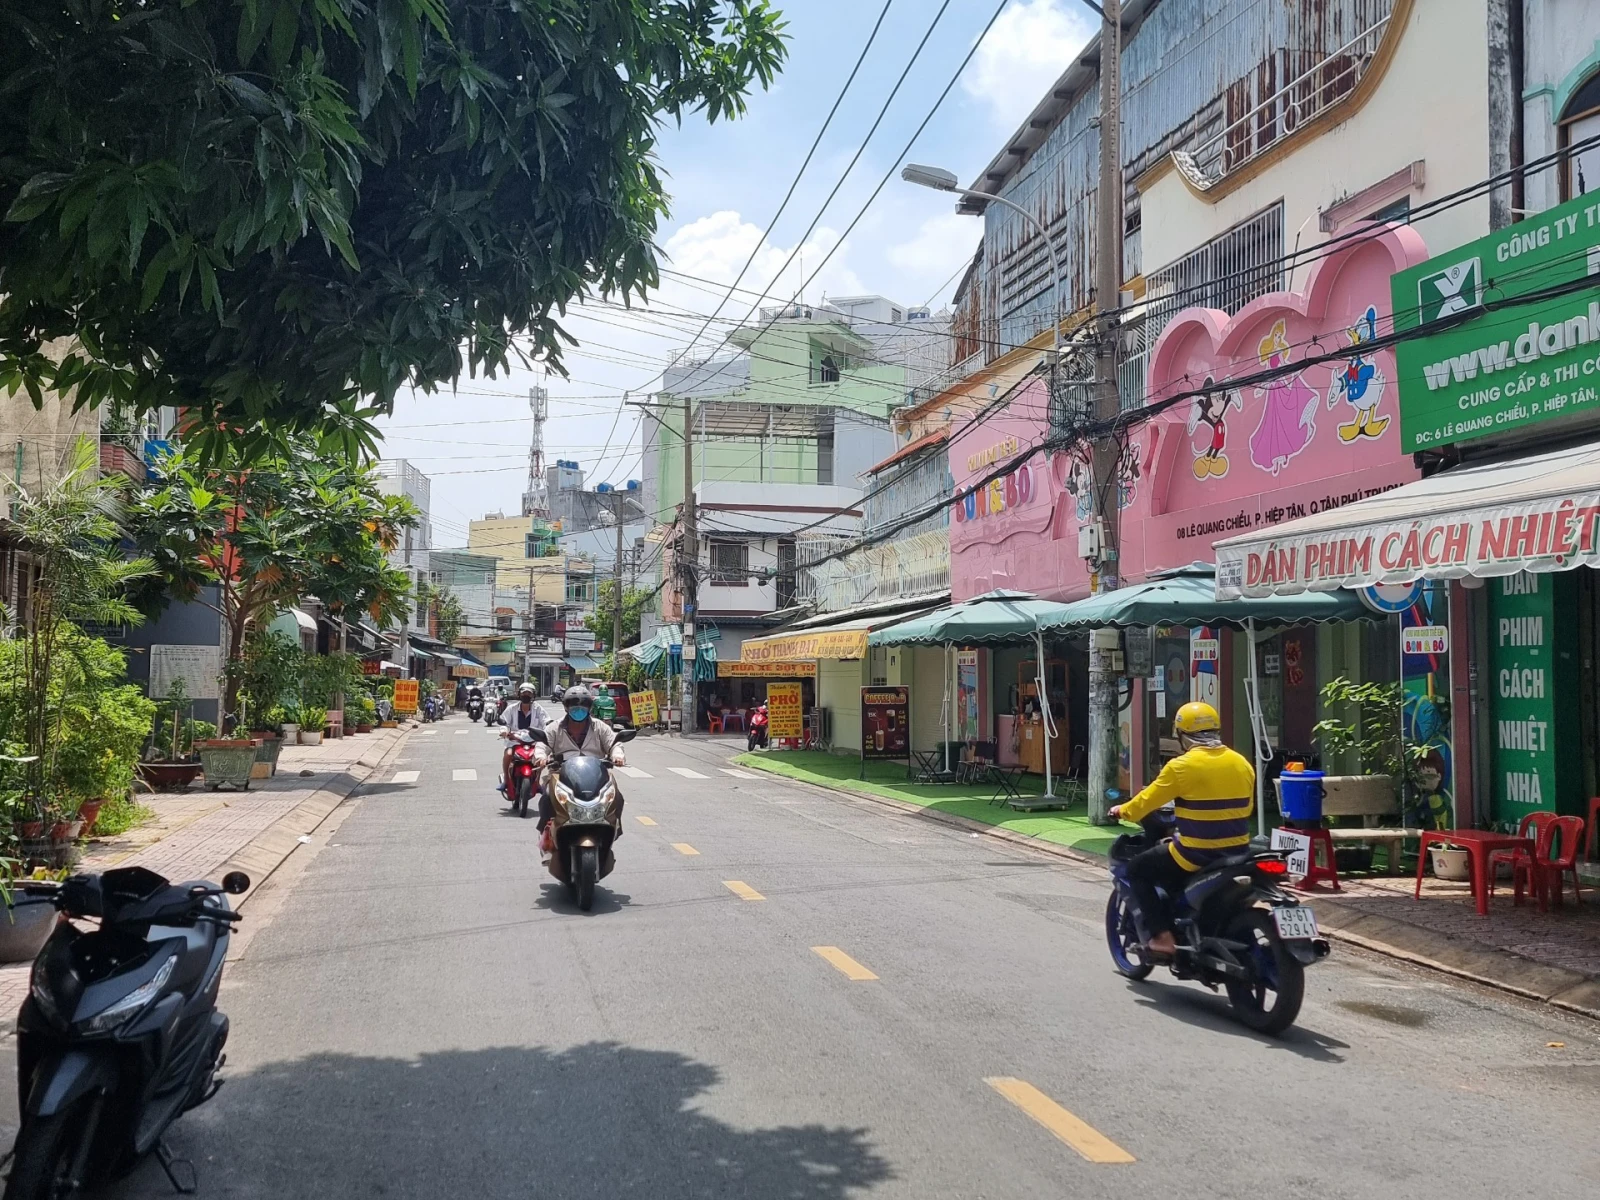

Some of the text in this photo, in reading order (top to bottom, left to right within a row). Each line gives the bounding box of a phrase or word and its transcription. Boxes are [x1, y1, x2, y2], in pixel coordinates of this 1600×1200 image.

[1496, 226, 1550, 262] CÔNG
[1554, 212, 1578, 240] TY
[1458, 386, 1501, 410] CUNG
[1504, 371, 1536, 397] CẤP
[1539, 372, 1550, 387] &
[1553, 362, 1579, 383] THI
[1415, 387, 1599, 445] ĐC: 6 LÊ QUANG CHIỂU, P. HIỆP TÂN,
[1177, 527, 1185, 539] 08
[1186, 523, 1196, 538] LÊ
[1196, 520, 1225, 536] QUANG
[1265, 506, 1284, 524] HIỆP
[1286, 502, 1306, 519] TÂN,
[1246, 542, 1298, 588] DÁN
[1304, 535, 1375, 581] PHIM
[1378, 520, 1472, 571] CÁCH
[1477, 499, 1600, 566] NHIỆT
[1500, 616, 1543, 647] PHIM
[769, 690, 798, 705] PHỞ
[865, 692, 890, 704] COFFEE
[1500, 662, 1544, 698] CÁCH
[1499, 715, 1547, 758] NHIỆT
[1506, 767, 1543, 804] NHÀ
[1290, 857, 1307, 873] PHÍ
[1280, 923, 1316, 938] 529.41
[1281, 909, 1309, 922] 49-G1
